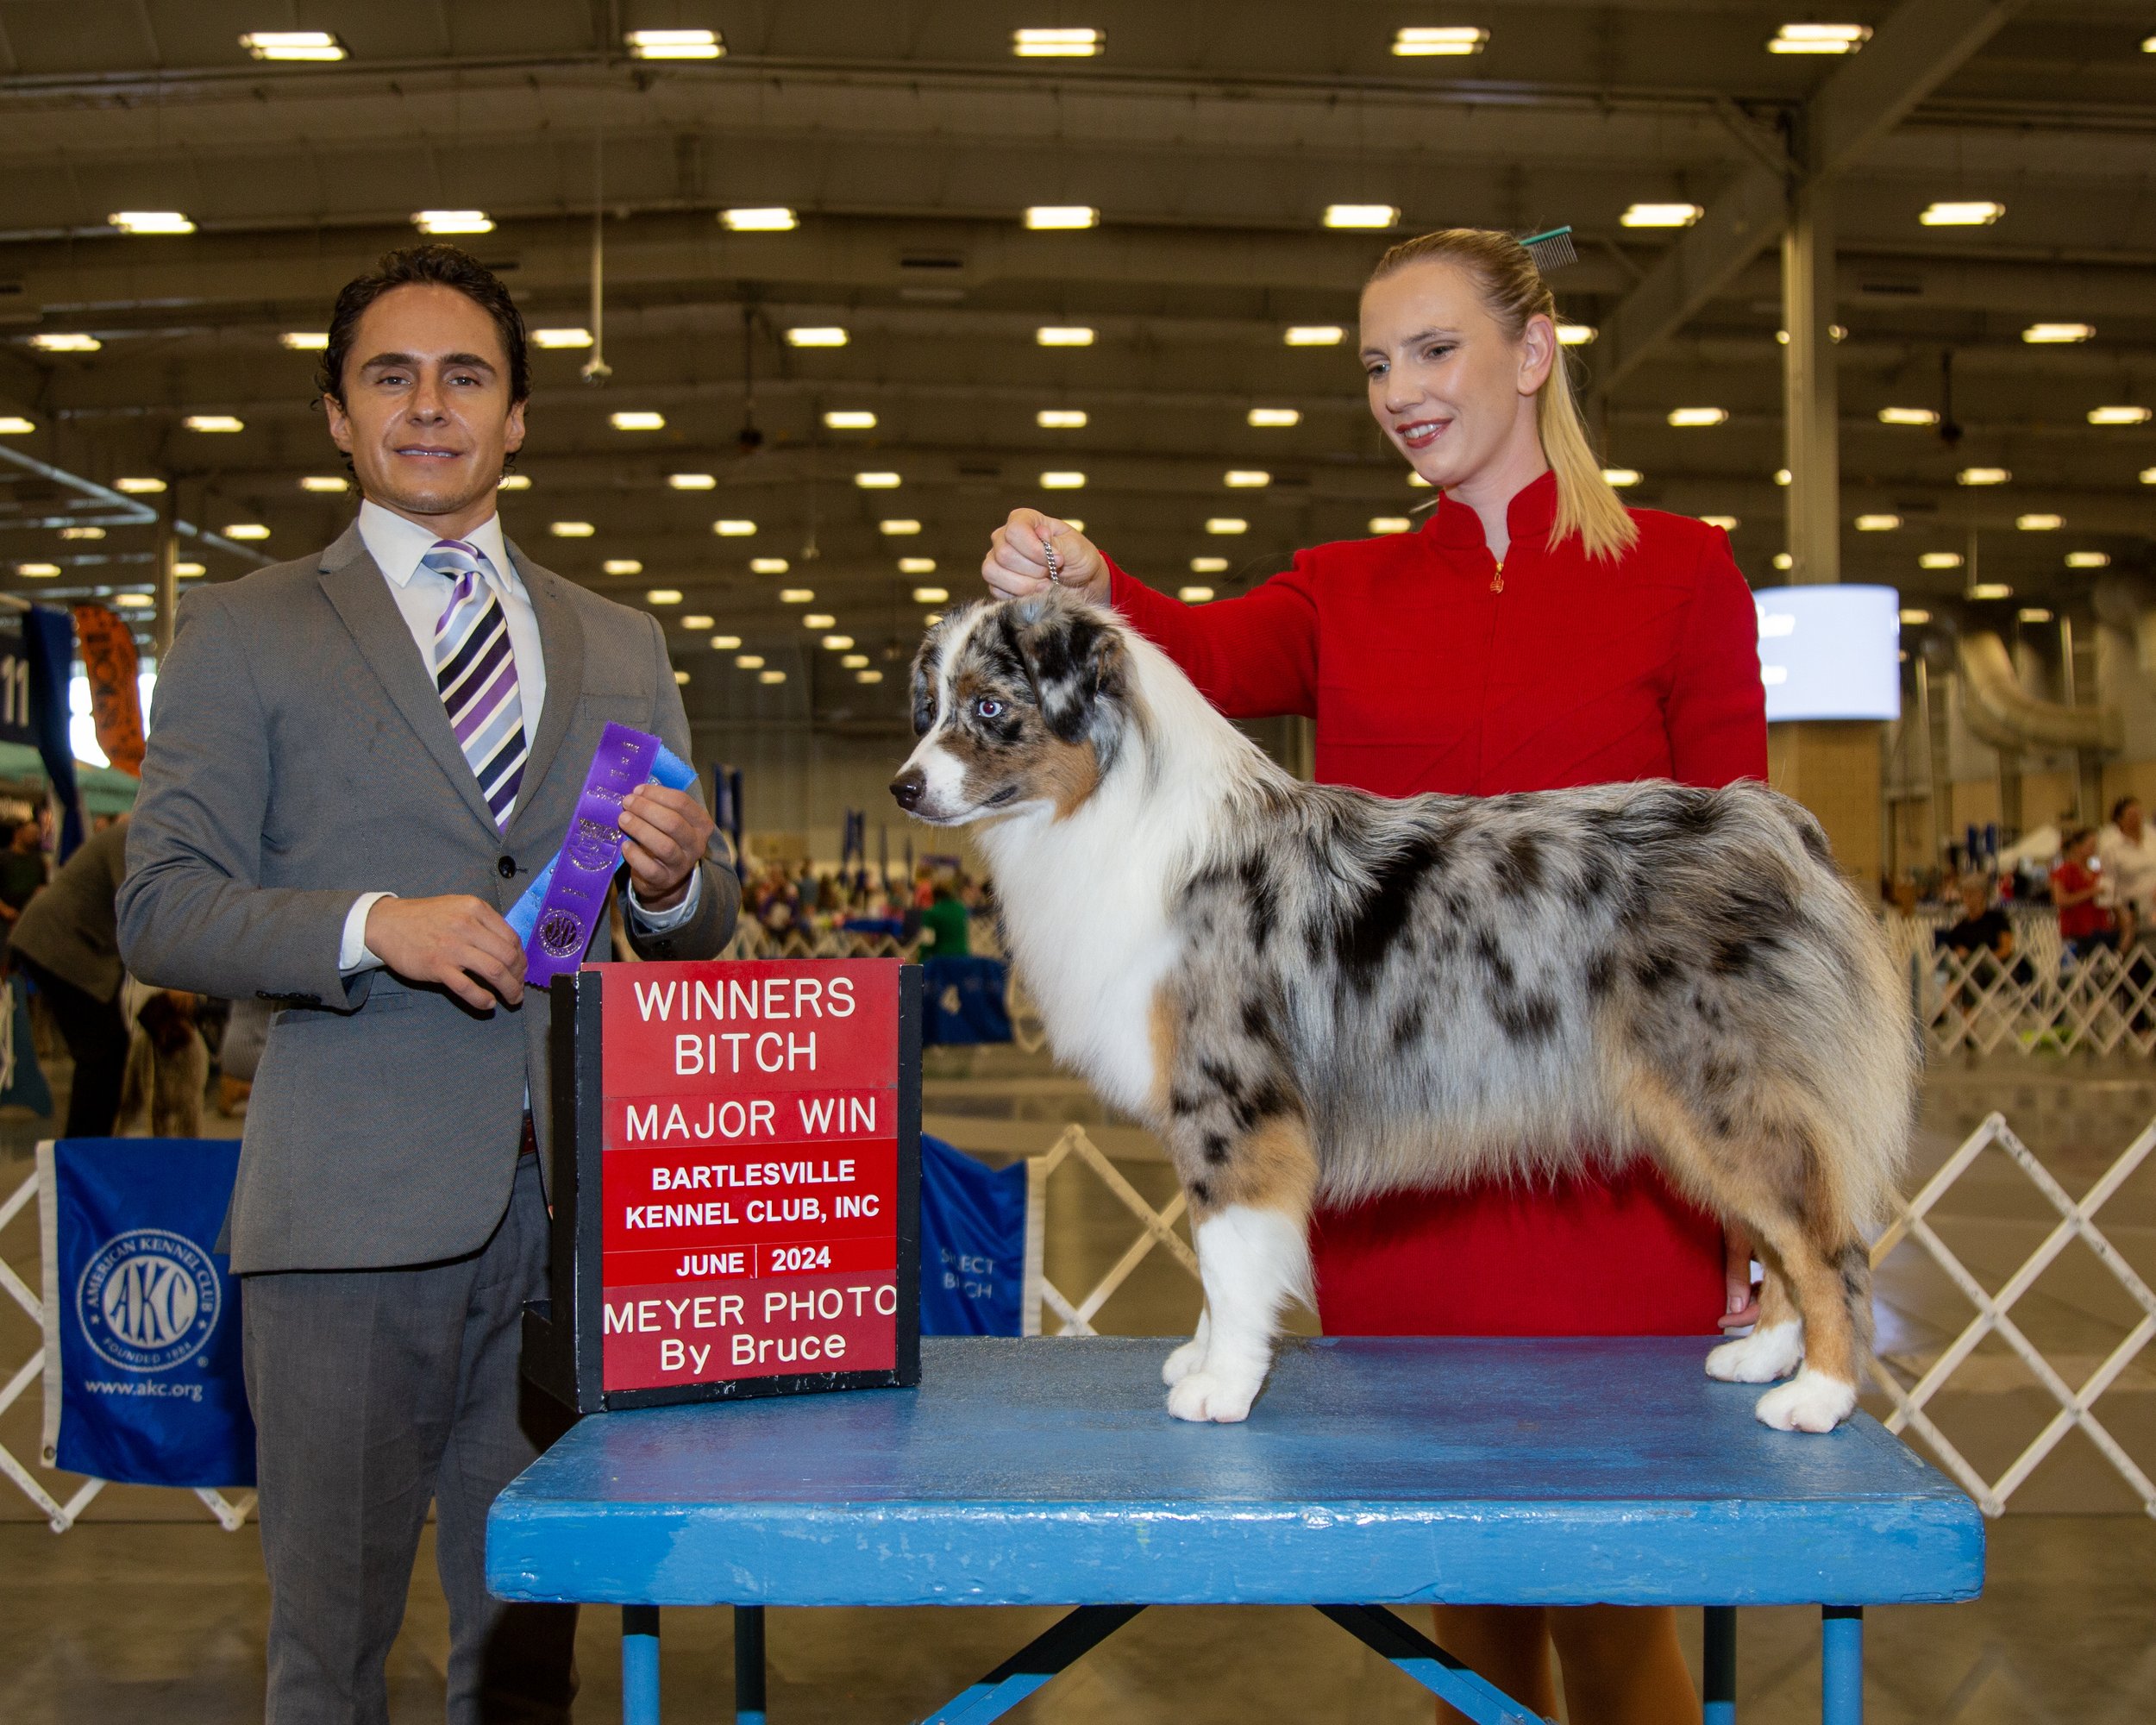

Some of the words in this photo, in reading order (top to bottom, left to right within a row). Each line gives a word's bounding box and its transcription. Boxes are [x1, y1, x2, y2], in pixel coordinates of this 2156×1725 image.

[634, 976, 856, 1021] WINNERS
[675, 1032, 817, 1076] BITCH
[627, 1100, 775, 1141] MAJOR
[799, 1096, 875, 1134] WIN
[652, 1159, 856, 1190] BARTLESVILLE
[625, 1202, 739, 1229] KENNEL
[747, 1197, 827, 1224] CLUB,
[836, 1195, 881, 1219] INC
[87, 1239, 136, 1308] AMERICAN
[139, 1238, 200, 1271] KENNEL
[196, 1270, 214, 1313] CLUB
[676, 1252, 745, 1276] JUNE
[771, 1246, 831, 1272] 2024
[110, 1260, 190, 1345] AKC
[604, 1295, 744, 1335] MEYER
[765, 1284, 898, 1324] PHOTO
[103, 1336, 160, 1364] FOUNDED
[661, 1339, 711, 1375] By
[731, 1333, 846, 1366] Bruce
[85, 1378, 204, 1402] www.akc.org
